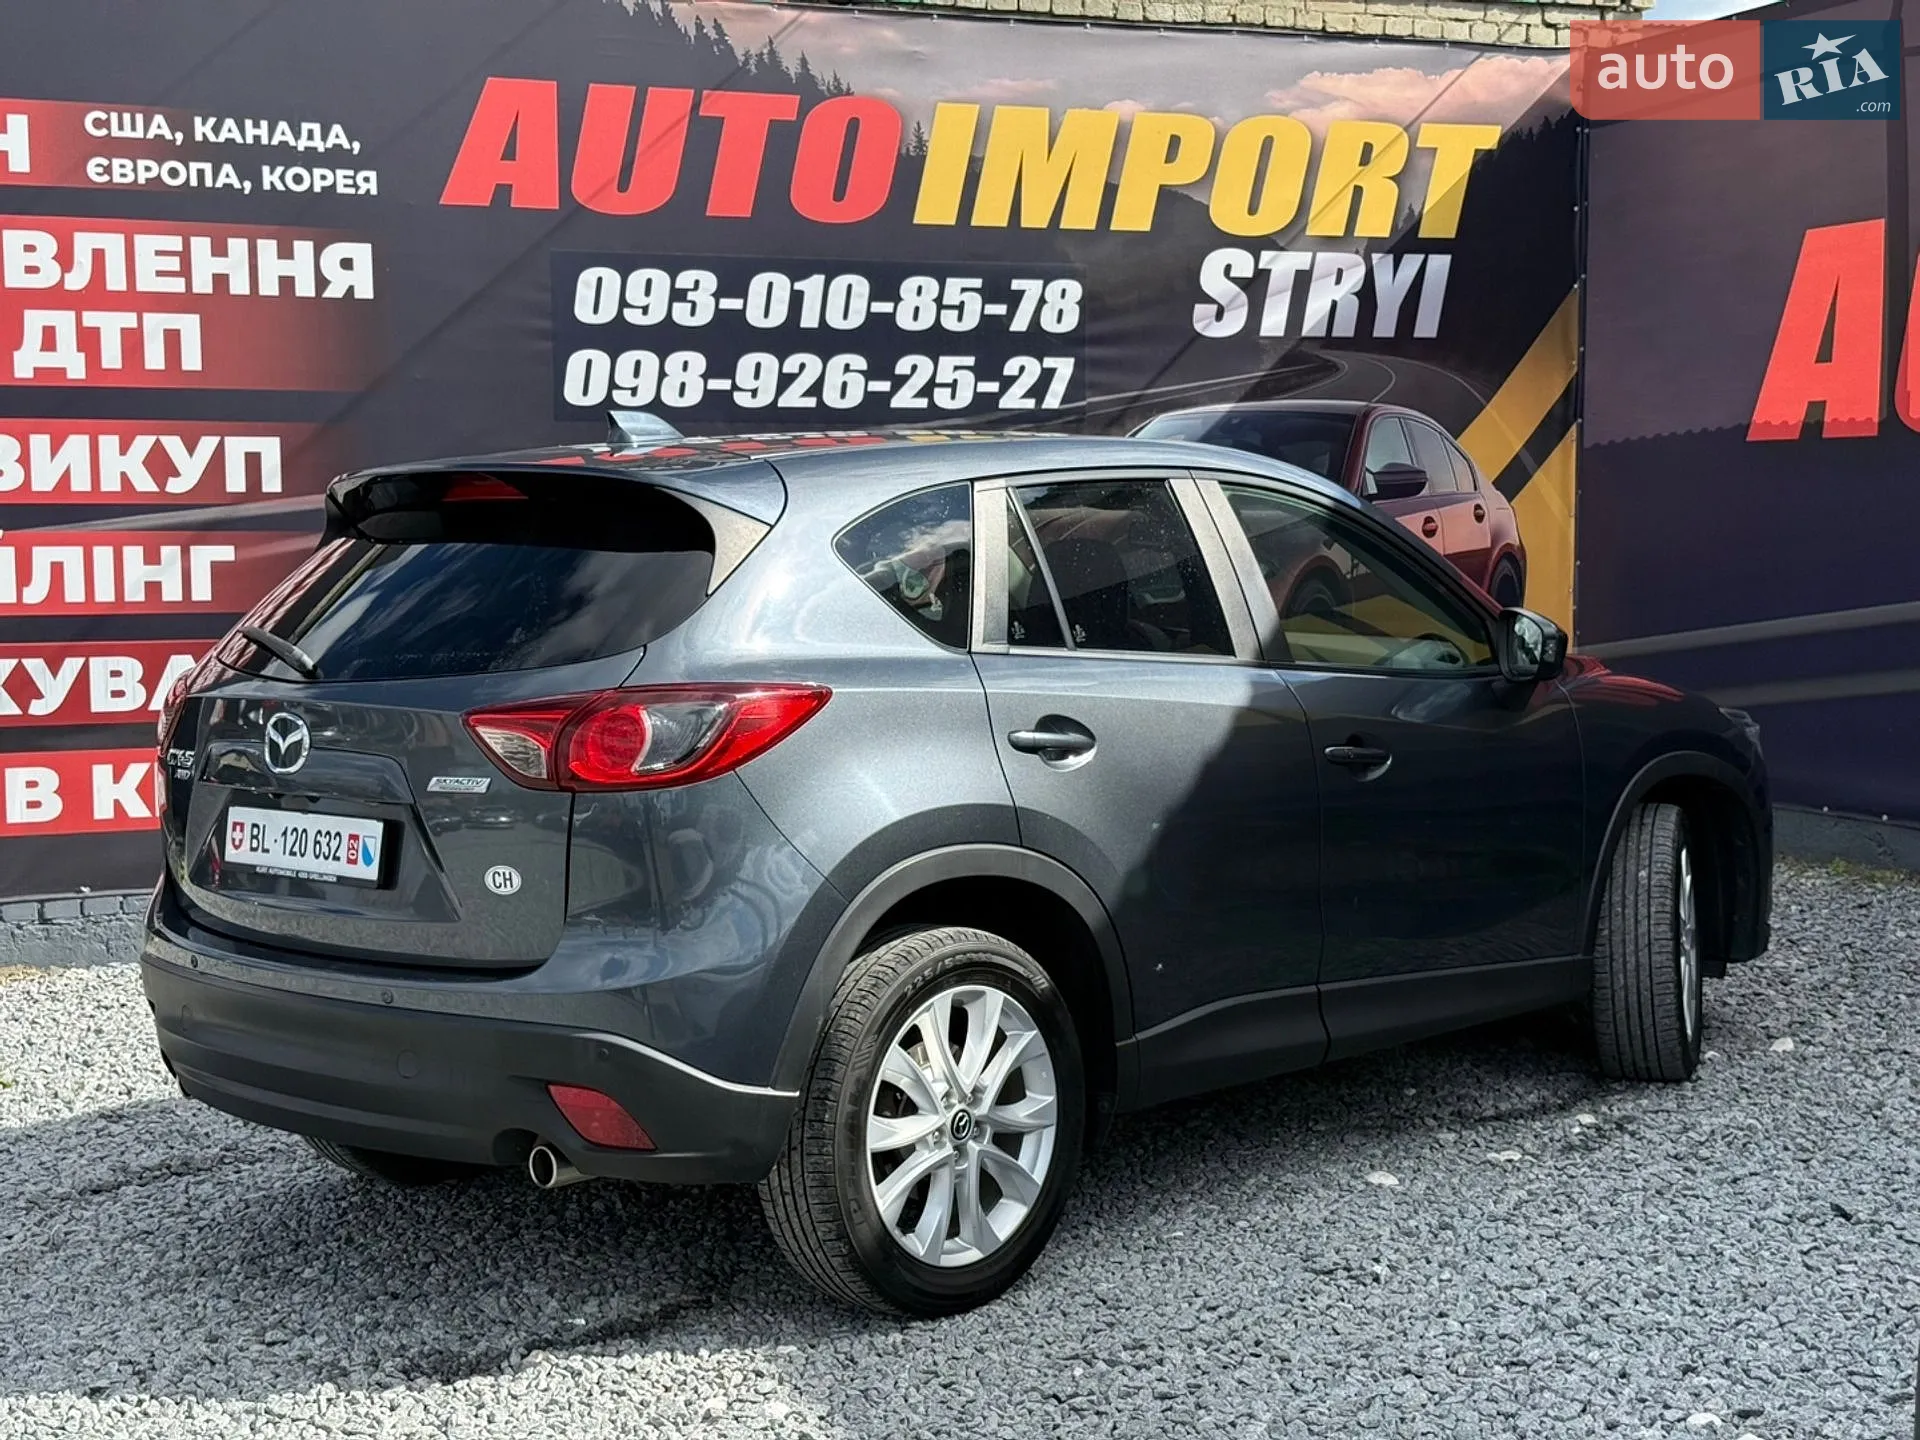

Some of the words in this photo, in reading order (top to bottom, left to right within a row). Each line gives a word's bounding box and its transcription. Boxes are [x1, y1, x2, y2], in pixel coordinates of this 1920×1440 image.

[84, 110, 184, 146] США,
[193, 116, 361, 154] КАНАДА,
[86, 157, 252, 194] ЄВРОПА,
[262, 165, 378, 196] КОРЕЯ
[573, 266, 1083, 334] 093-010-85-78
[1192, 247, 1452, 338] STRYI
[13, 309, 203, 380] ДТП
[1745, 217, 1920, 442] A
[563, 348, 1076, 411] 098-926-25-27
[0, 529, 236, 605] ЛІНГ
[4, 766, 64, 824] В
[92, 762, 161, 820] К
[248, 822, 271, 855] BL
[280, 826, 308, 858] 120
[312, 828, 342, 862] 632
[491, 870, 514, 890] CH
